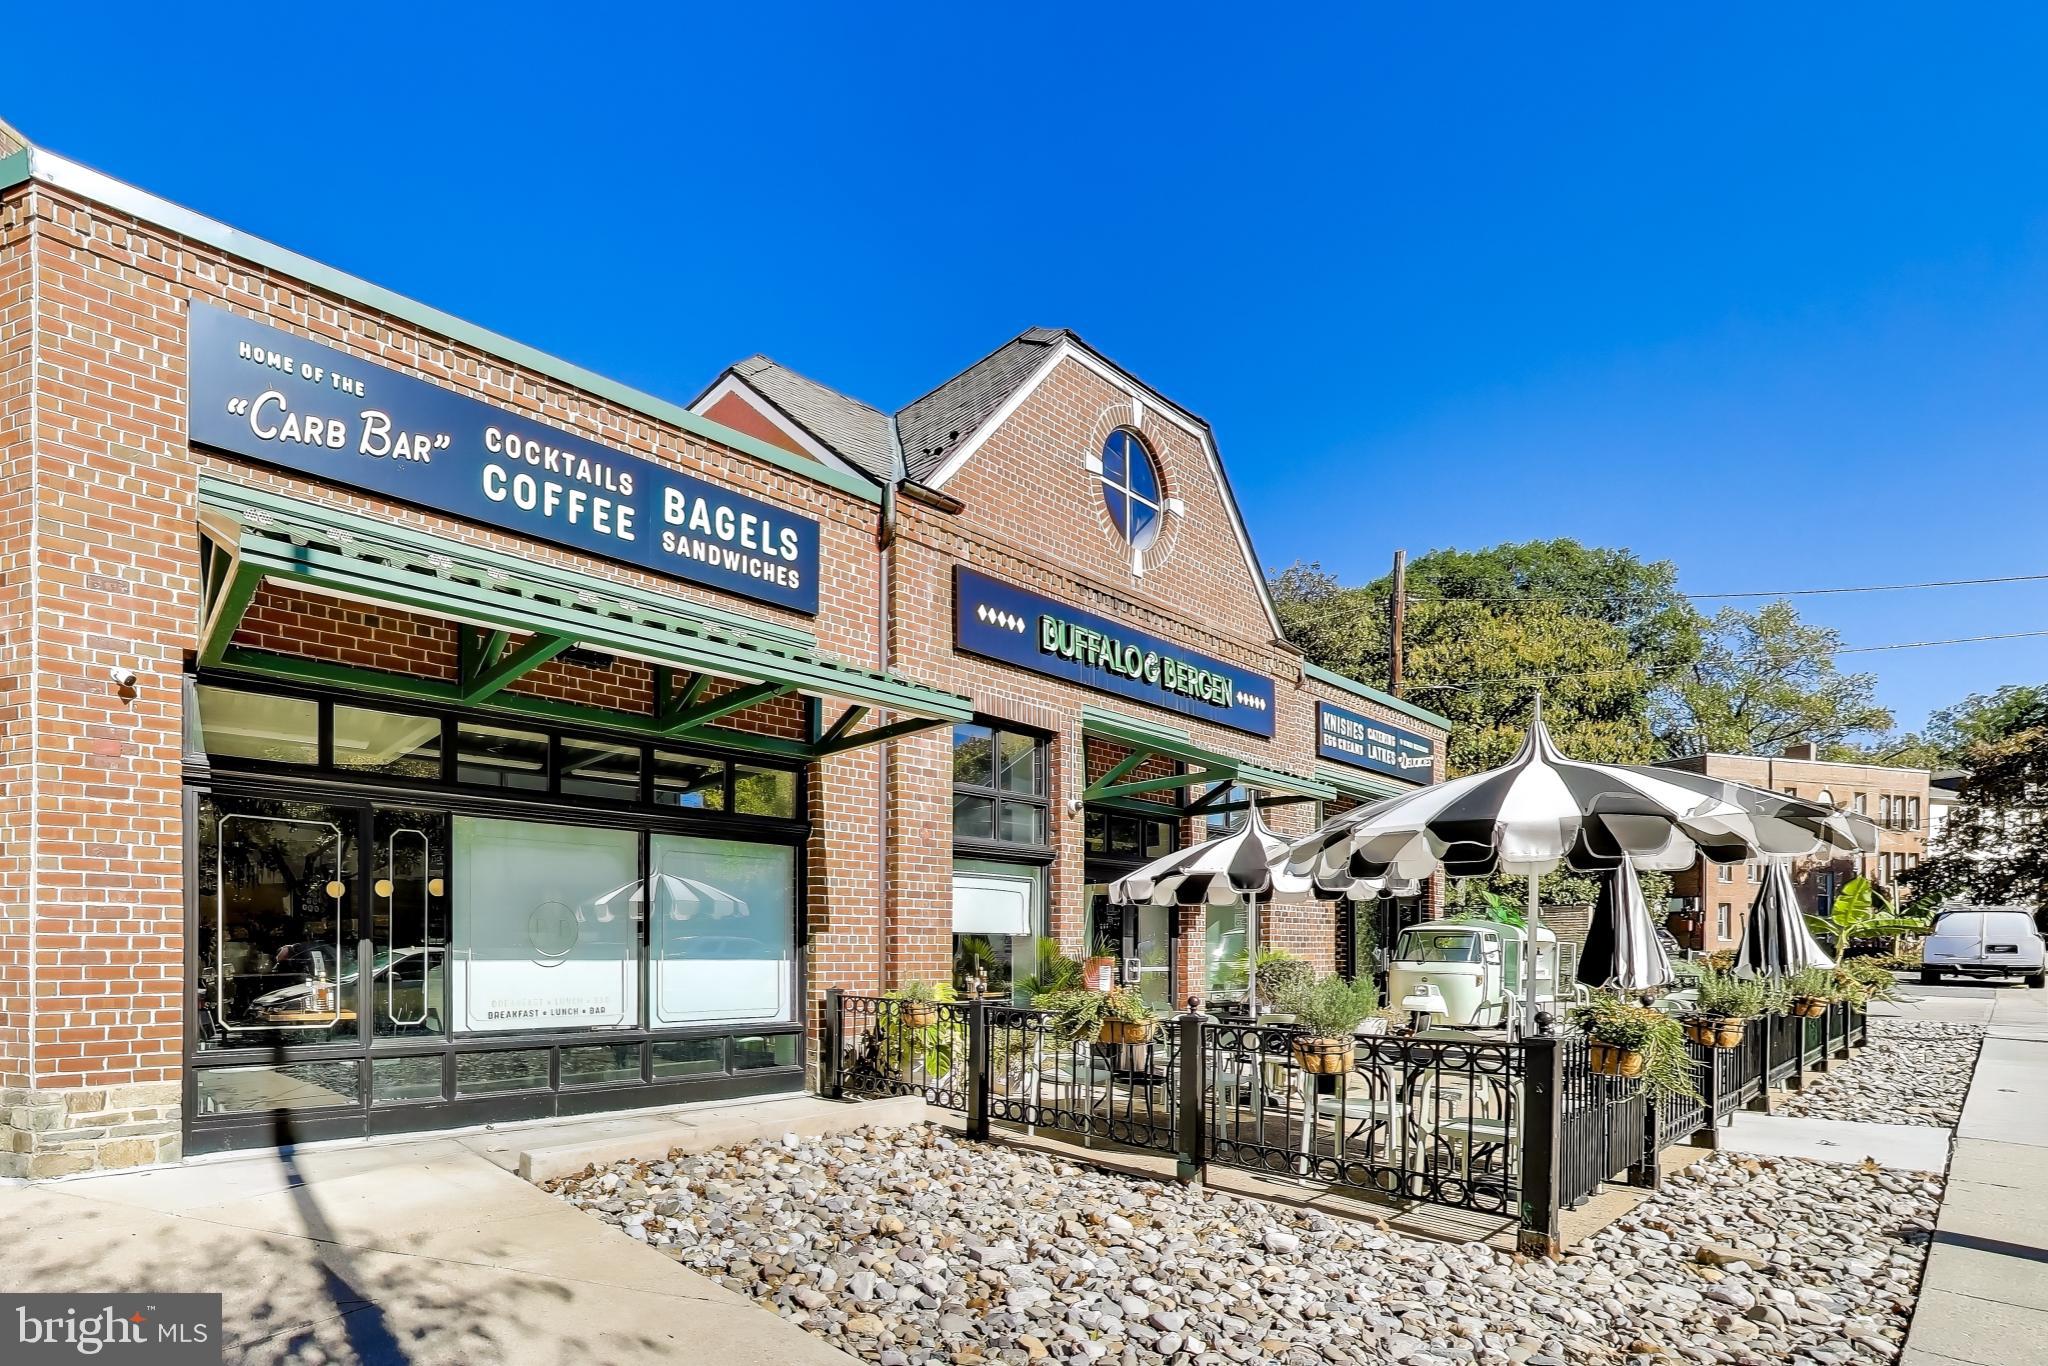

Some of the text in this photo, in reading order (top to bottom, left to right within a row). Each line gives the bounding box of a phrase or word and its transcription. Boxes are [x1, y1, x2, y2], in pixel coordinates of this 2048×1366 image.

[239, 341, 365, 398] HOME OF THE
[484, 426, 634, 497] COCKTAILS
[482, 462, 638, 543] COFFEE
[663, 486, 800, 562] BAGELS
[661, 530, 801, 590] SANDWICHES
[1040, 614, 1144, 680] BUFFALO
[1160, 656, 1234, 708] BERGEN
[1323, 711, 1364, 741] KNISHES
[1367, 743, 1396, 766] LATKES
[487, 1006, 606, 1020] BREAKFAST LUNCH BAR
